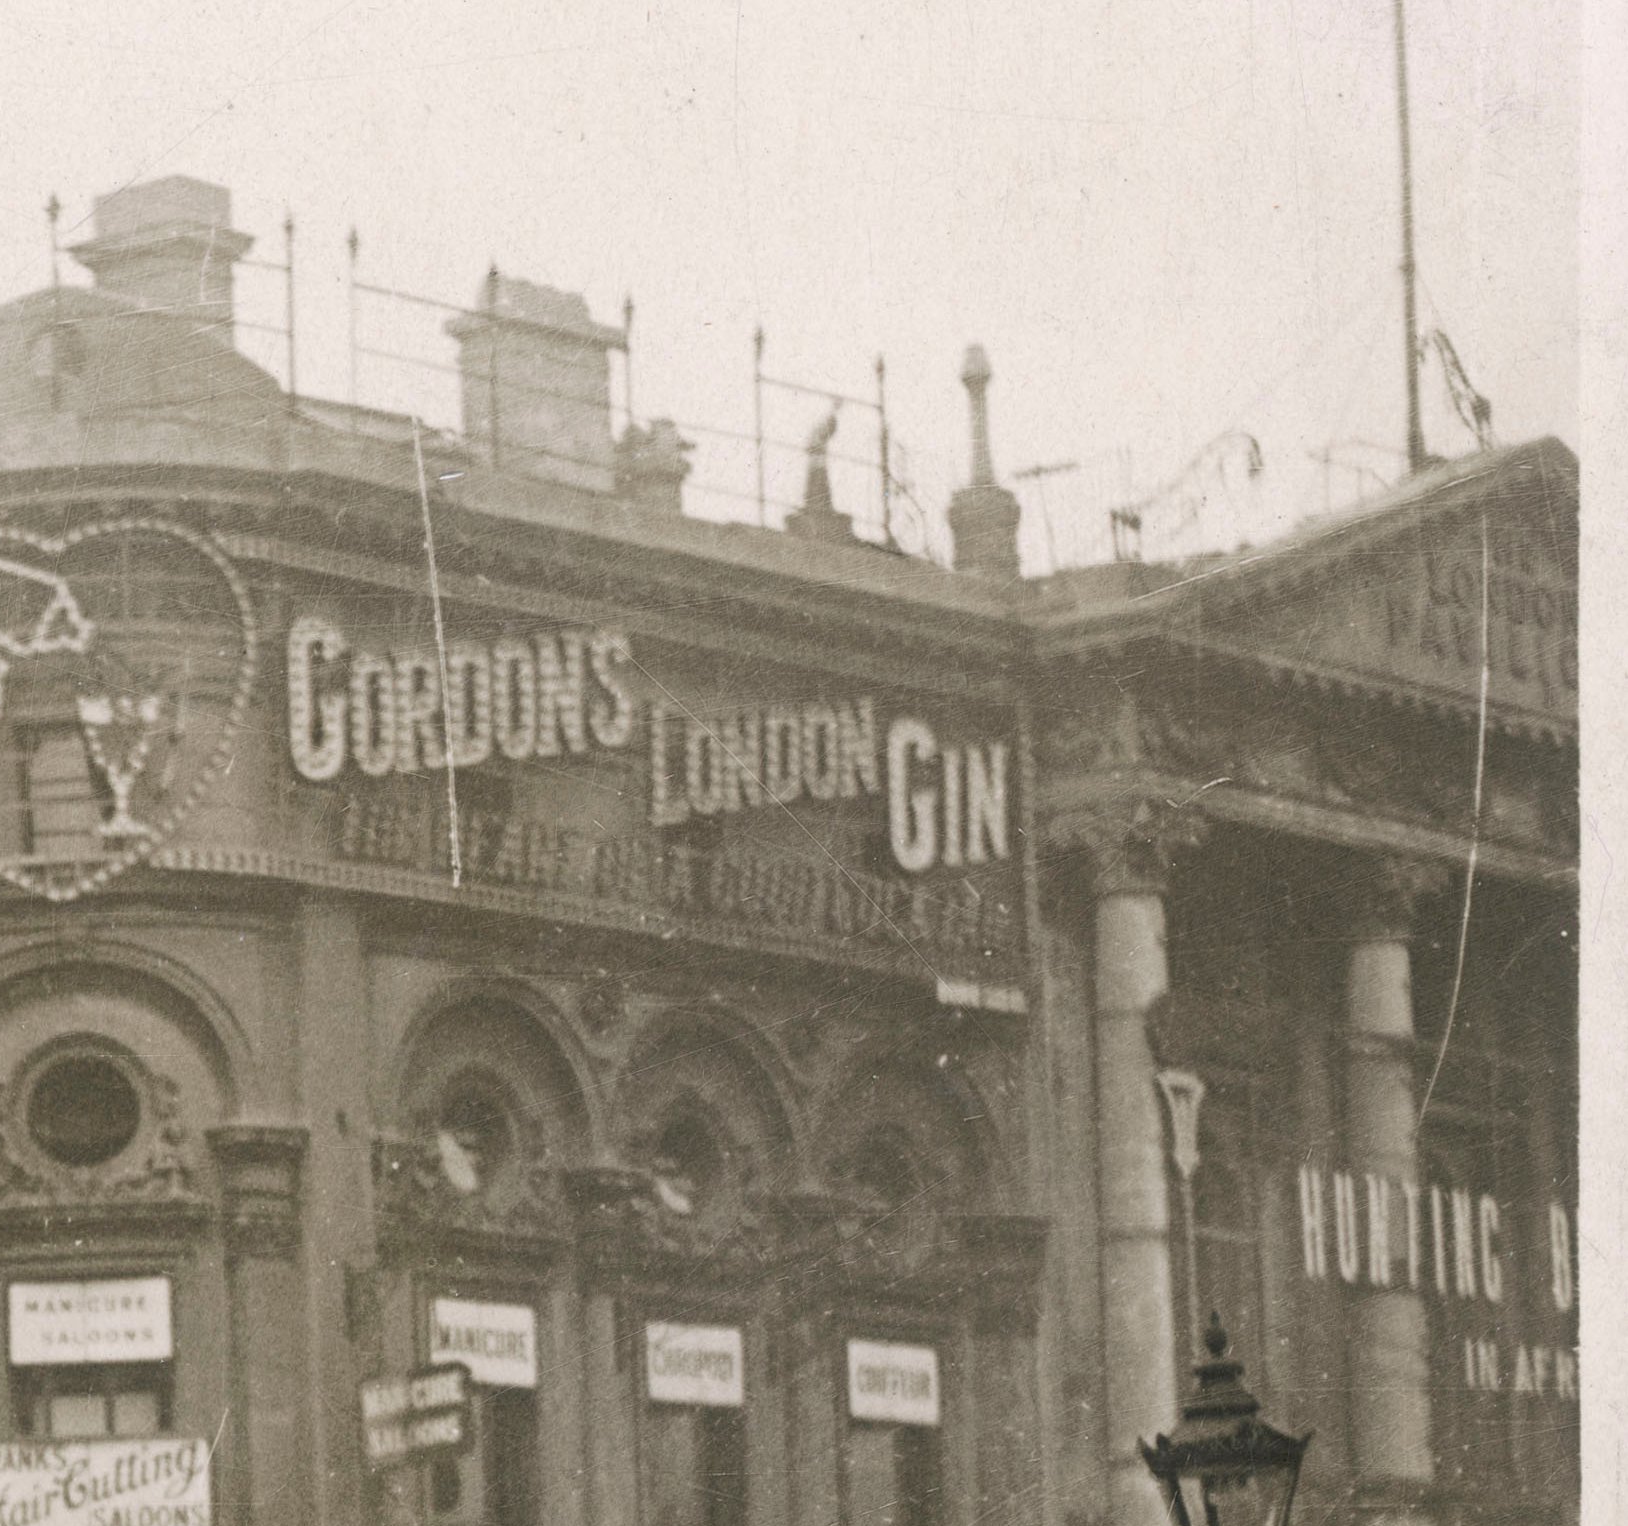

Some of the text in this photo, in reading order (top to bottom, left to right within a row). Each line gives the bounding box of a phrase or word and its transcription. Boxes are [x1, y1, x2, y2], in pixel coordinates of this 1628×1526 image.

[650, 696, 880, 828] LONDON
[886, 716, 1011, 873] GIN
[1298, 1165, 1503, 1303] HUNTING
[25, 1295, 147, 1314] MANICURE
[40, 1328, 155, 1346] SALOONS
[432, 1326, 529, 1363] MANICURE
[1465, 1337, 1576, 1400] IN AFR
[53, 1440, 205, 1510] Cutting
